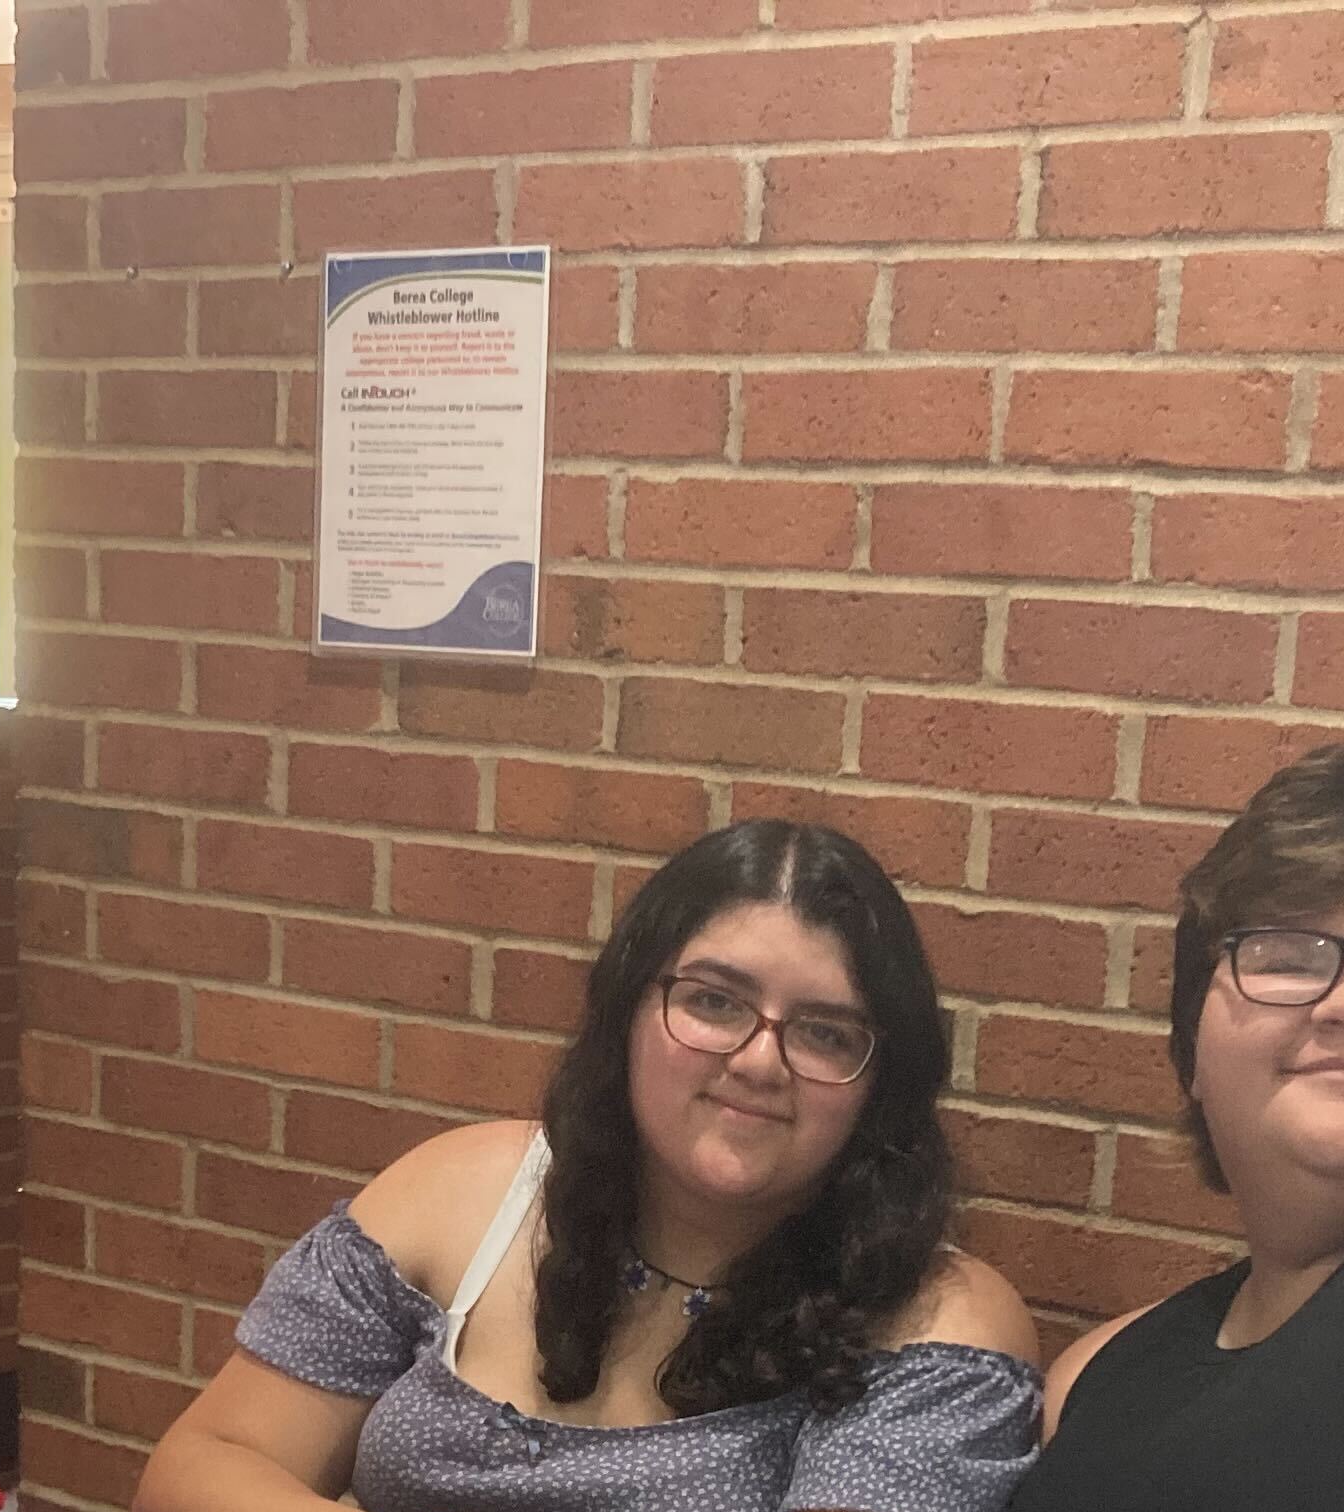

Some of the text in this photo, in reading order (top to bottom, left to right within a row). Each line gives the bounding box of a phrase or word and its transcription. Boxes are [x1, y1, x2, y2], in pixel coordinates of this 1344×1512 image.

[393, 288, 474, 304] Berea College
[368, 309, 500, 325] Whistleblower Hotline
